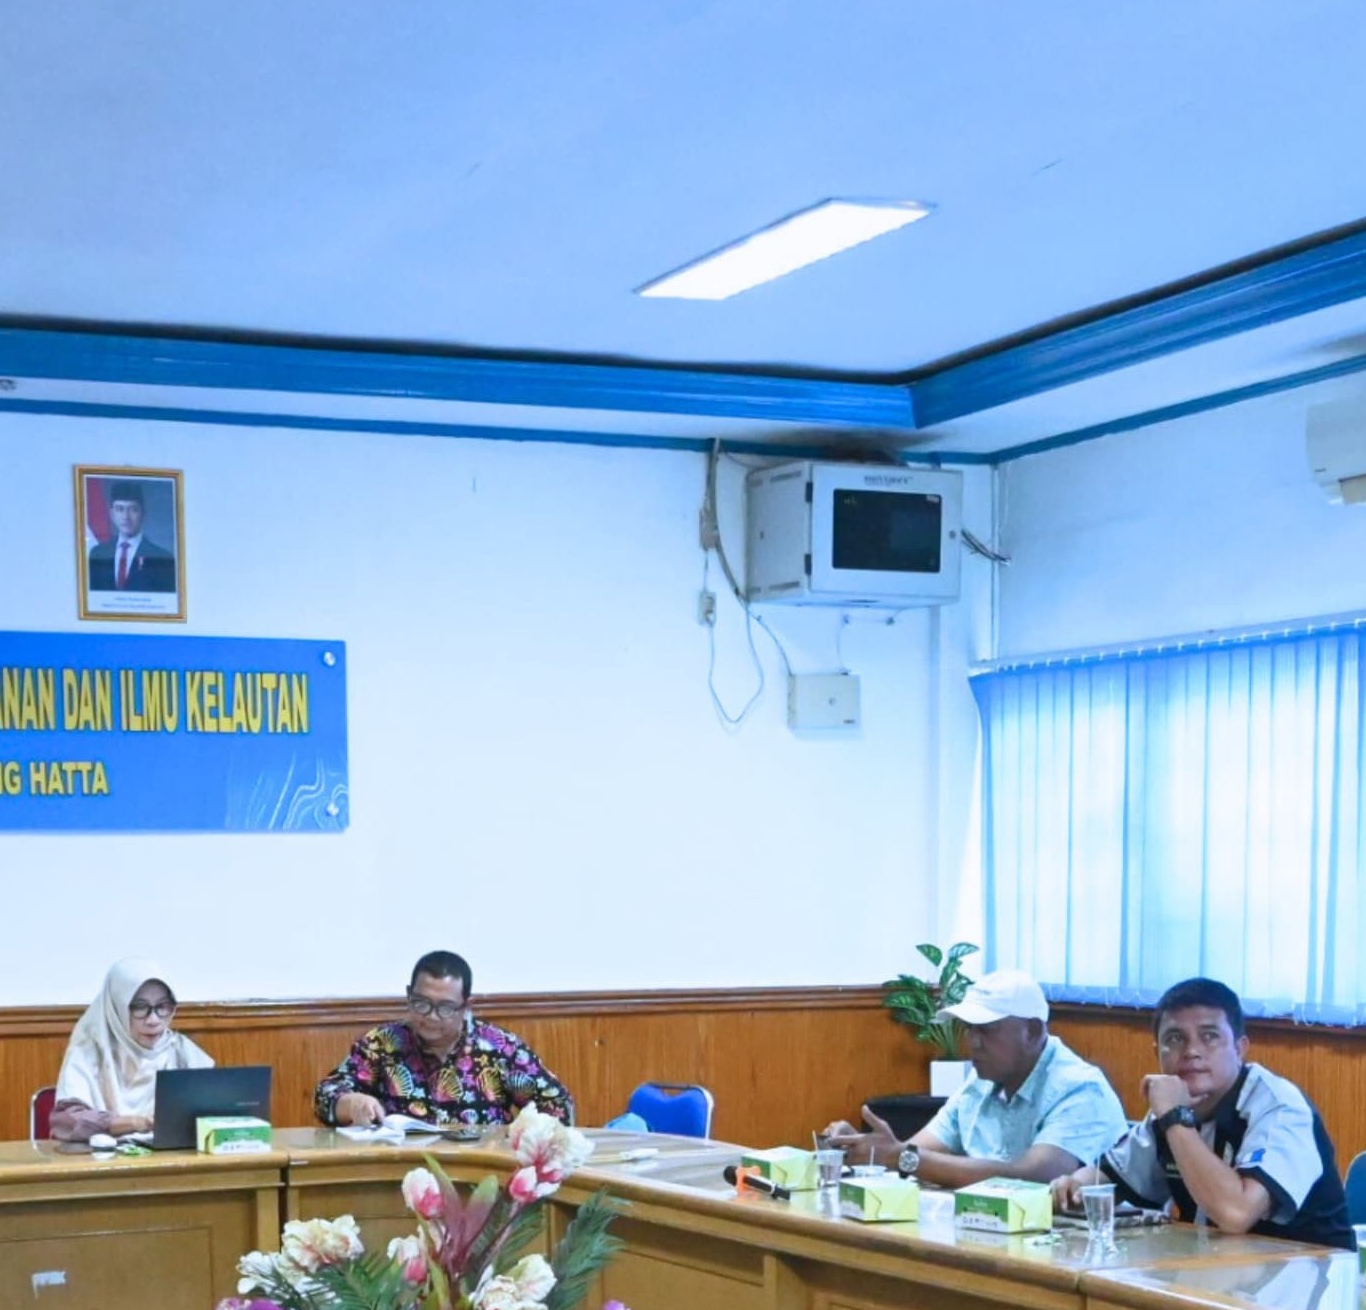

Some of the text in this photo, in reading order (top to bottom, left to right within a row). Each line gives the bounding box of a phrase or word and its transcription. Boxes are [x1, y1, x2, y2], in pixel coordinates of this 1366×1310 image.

[62, 668, 112, 732] DAN
[119, 670, 179, 732] ILMU
[186, 671, 309, 734] KELAUTAN
[30, 761, 109, 795] HATTA
